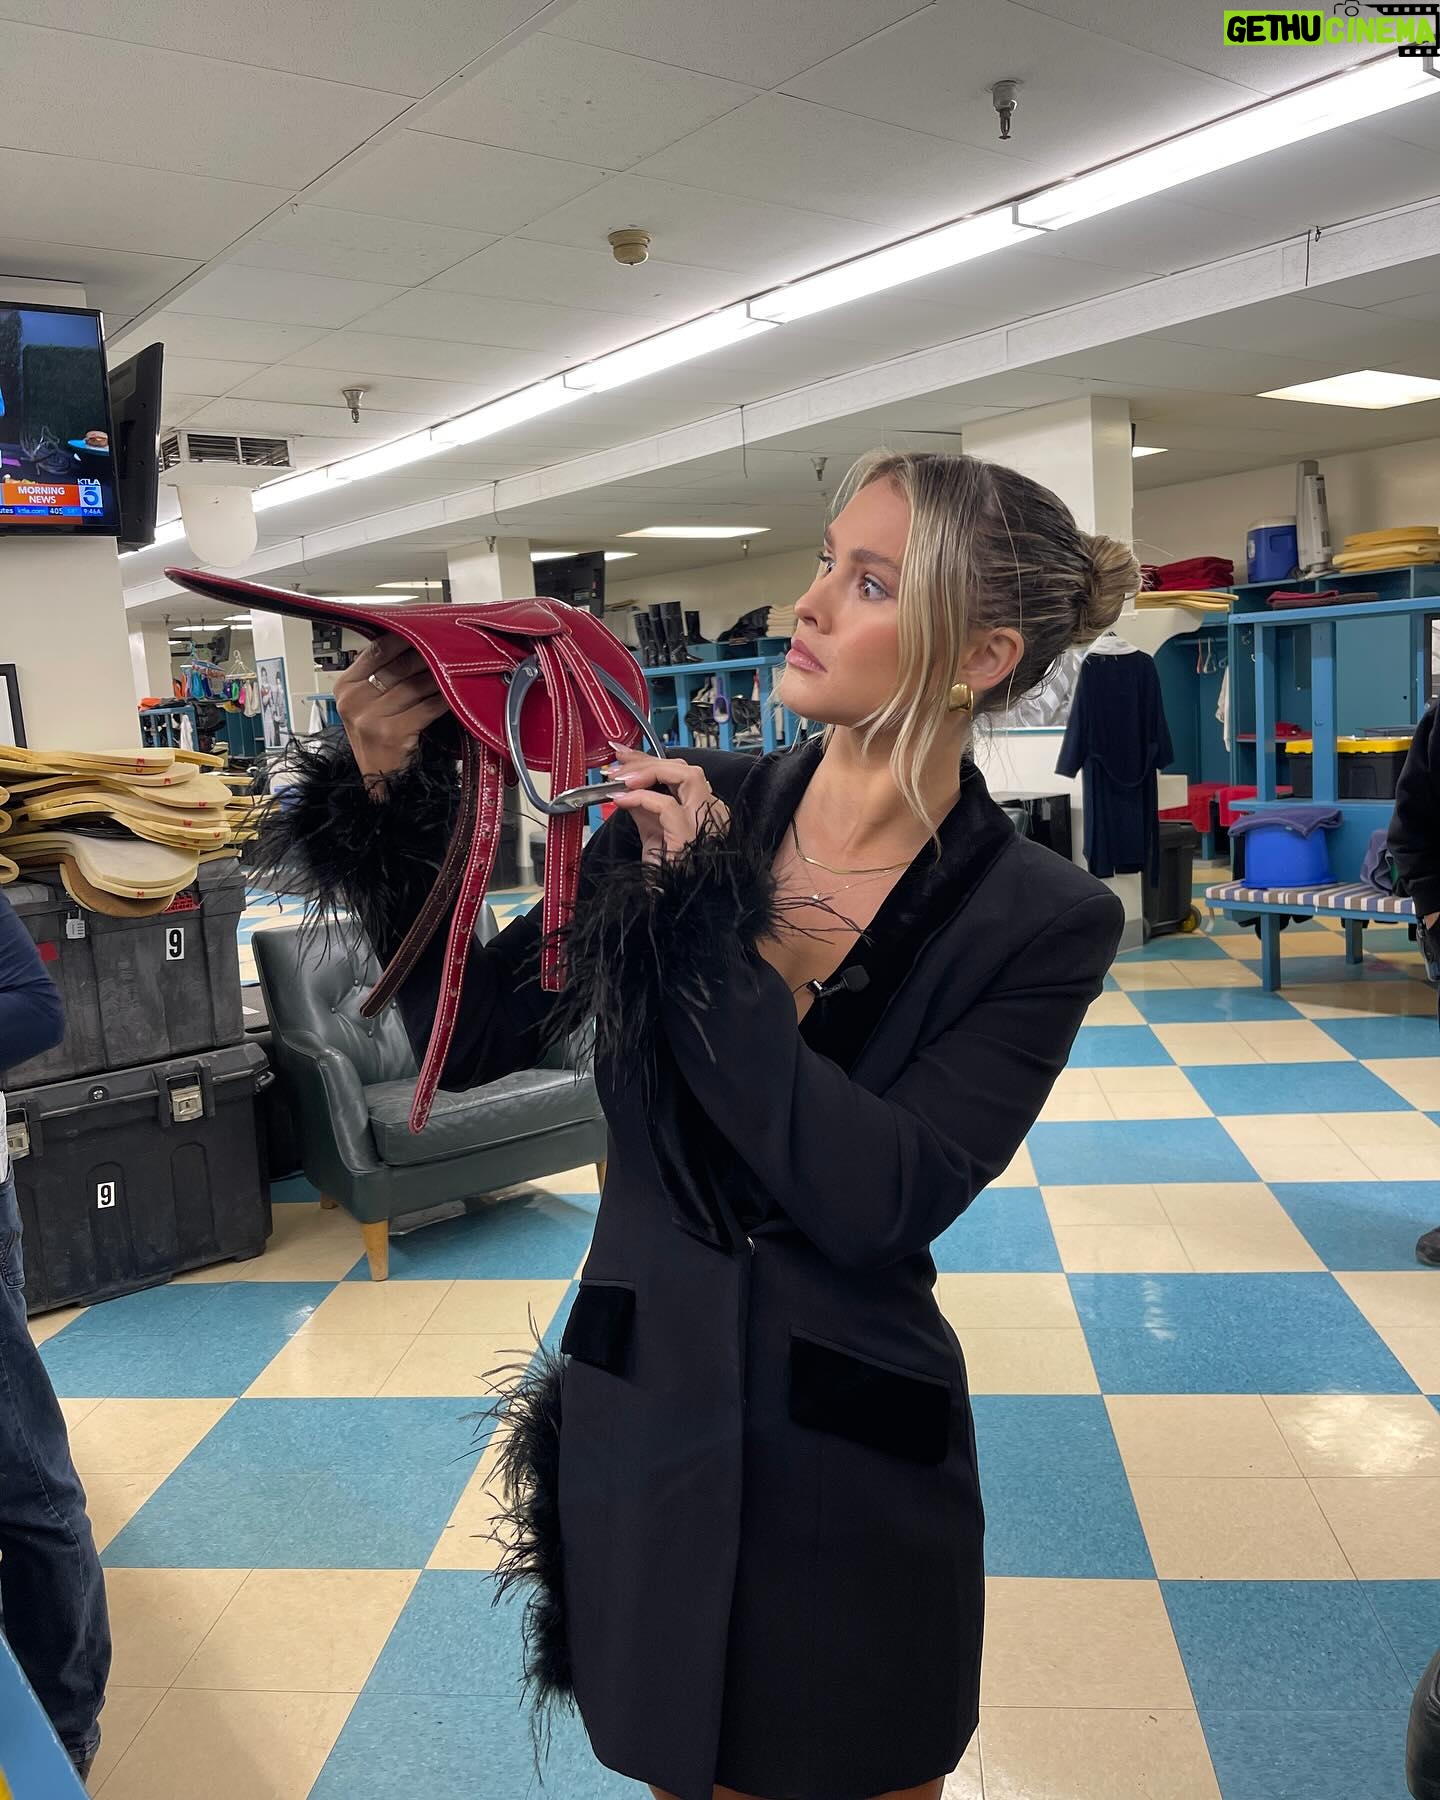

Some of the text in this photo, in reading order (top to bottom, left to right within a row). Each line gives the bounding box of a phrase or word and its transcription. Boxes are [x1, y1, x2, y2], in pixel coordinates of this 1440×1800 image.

[77, 478, 101, 486] KTLA
[17, 486, 65, 495] MORNING
[28, 495, 57, 504] NEWS
[83, 486, 99, 506] 5
[49, 507, 64, 515] 405
[169, 929, 182, 958] 9
[100, 1184, 112, 1206] 9
